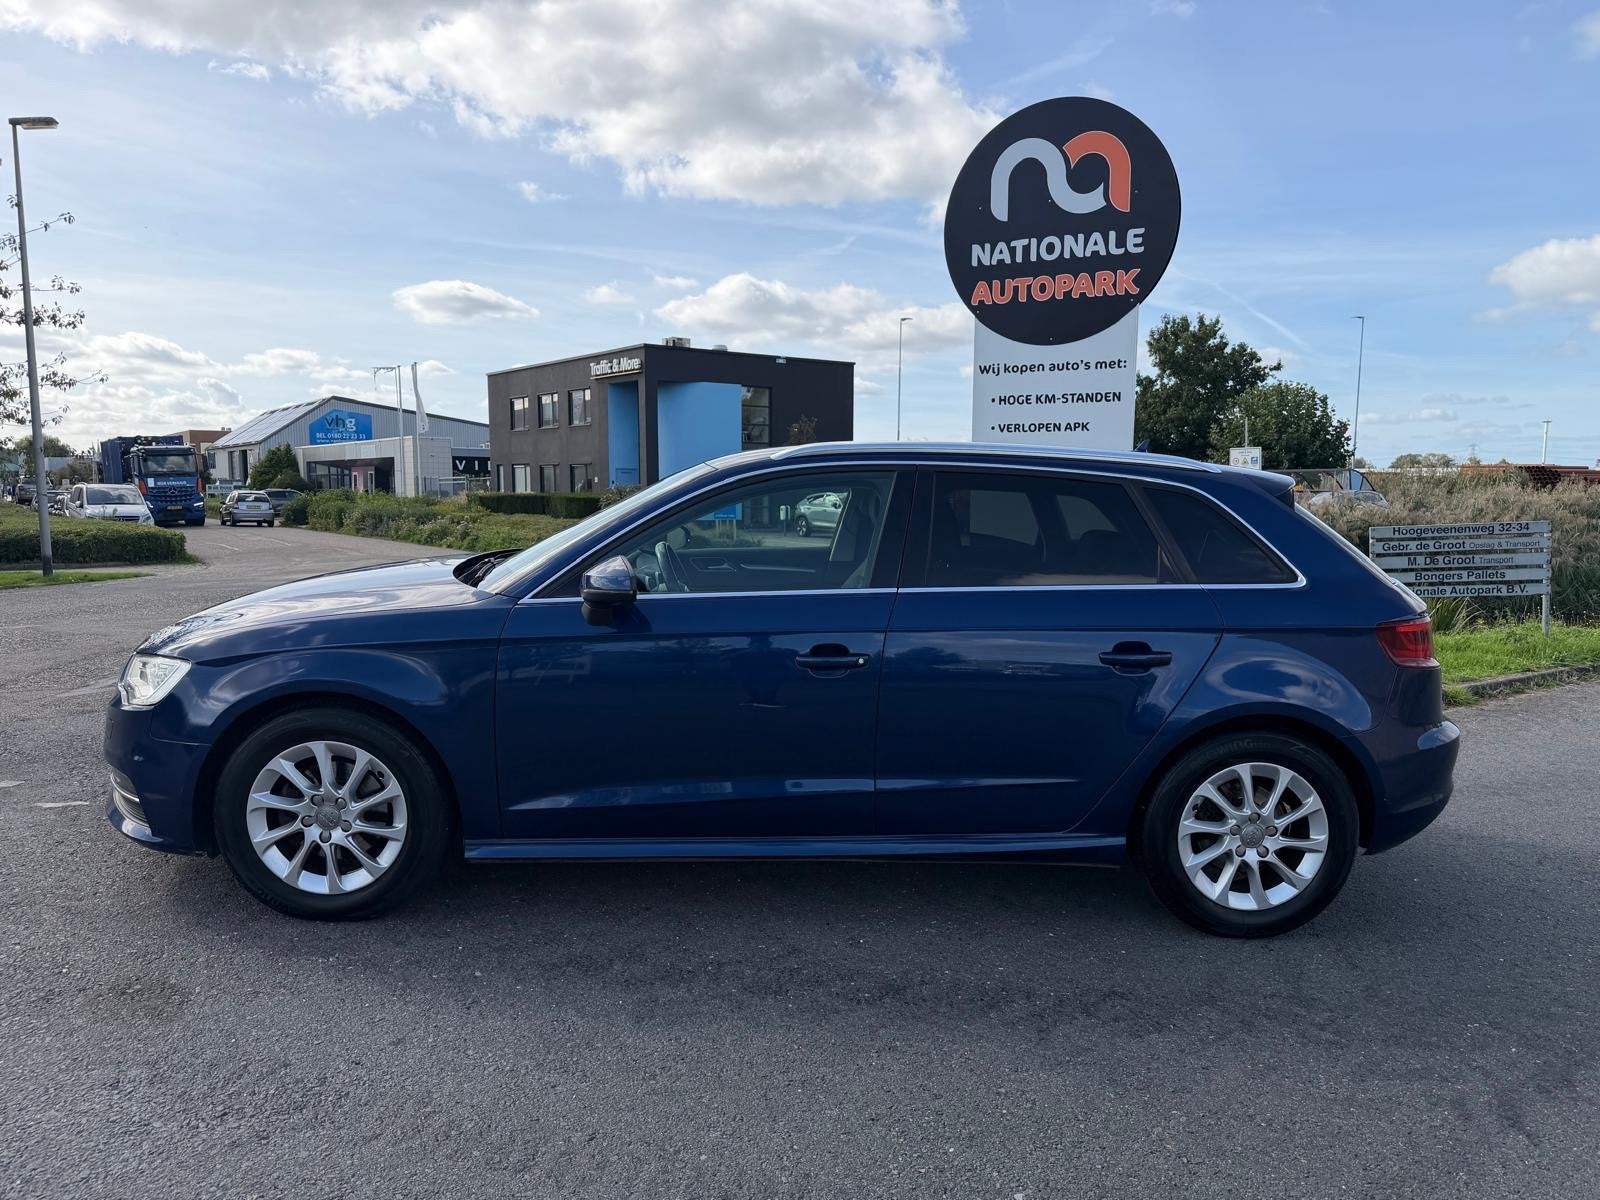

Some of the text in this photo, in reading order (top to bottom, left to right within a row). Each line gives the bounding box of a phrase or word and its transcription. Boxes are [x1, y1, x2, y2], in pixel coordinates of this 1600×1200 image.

[971, 227, 1146, 267] NATIONALE
[970, 268, 1141, 306] AUTOPARK
[590, 360, 612, 376] Traffic
[612, 358, 619, 373] &
[979, 358, 1127, 376] Wij kopen auto's met:
[998, 391, 1122, 406] HOGE KM-STANDEN
[325, 414, 356, 432] vhg
[998, 421, 1090, 433] VERLOPEN APK
[1392, 522, 1530, 537] Hoogeveenenweg 32-34
[1382, 542, 1413, 552] Gebr.
[1415, 541, 1430, 551] de
[1433, 540, 1466, 550] Groot
[1505, 540, 1541, 549] Transport
[1407, 555, 1514, 567] M. De Groot Transport
[1414, 571, 1507, 583] Bongers Pallets
[1449, 586, 1503, 597] Autopark
[1506, 584, 1529, 595] B.V.
